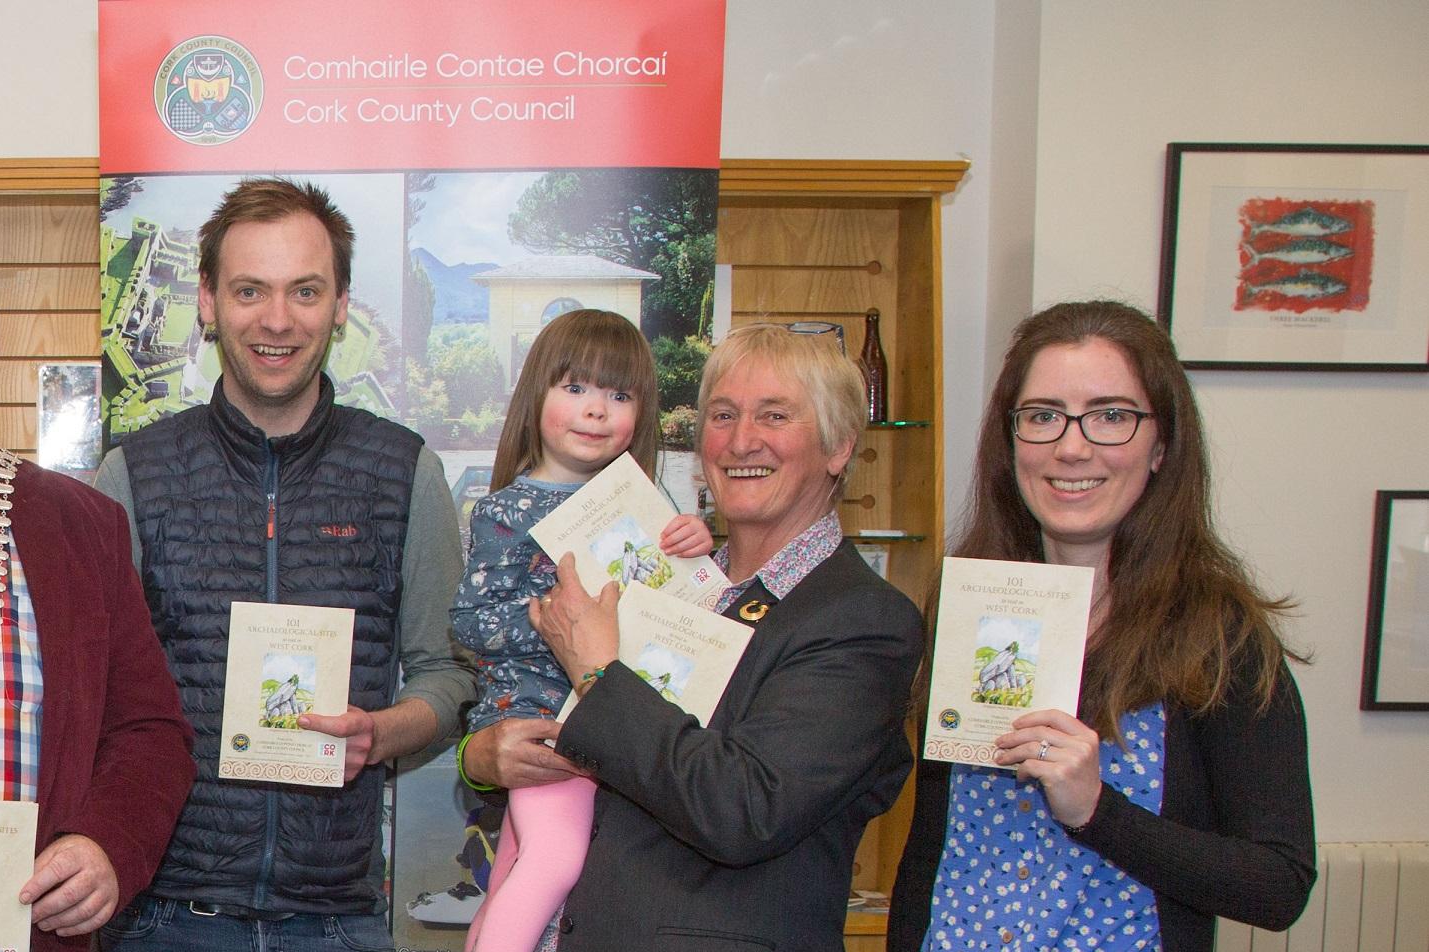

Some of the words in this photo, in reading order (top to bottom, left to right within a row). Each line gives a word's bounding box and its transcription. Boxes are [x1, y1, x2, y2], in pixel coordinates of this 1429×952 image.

[160, 54, 180, 79] CORK
[180, 39, 221, 53] COUNTY
[225, 42, 257, 78] COUNCIL
[283, 52, 428, 81] Comhairle
[435, 52, 545, 78] Contae
[552, 50, 668, 77] Chorcaí
[283, 98, 348, 124] Cork
[356, 97, 462, 128] County
[469, 94, 575, 122] Council
[580, 498, 596, 513] 101
[332, 524, 357, 537] Rab
[1007, 577, 1023, 587] 101
[960, 584, 1047, 598] ARCHAEOLOGICAL
[1047, 590, 1070, 600] SITES
[986, 604, 1009, 613] WEST
[1011, 606, 1038, 616] CORK
[286, 618, 300, 629] 101
[639, 609, 708, 643] ARCHAEOLOGICAL
[680, 616, 694, 628] 101
[247, 625, 316, 637] ARCHAEOLOGICAL
[268, 642, 291, 651] WEST
[292, 644, 315, 653] CORK
[654, 634, 675, 648] WEST
[675, 642, 696, 657] CORK
